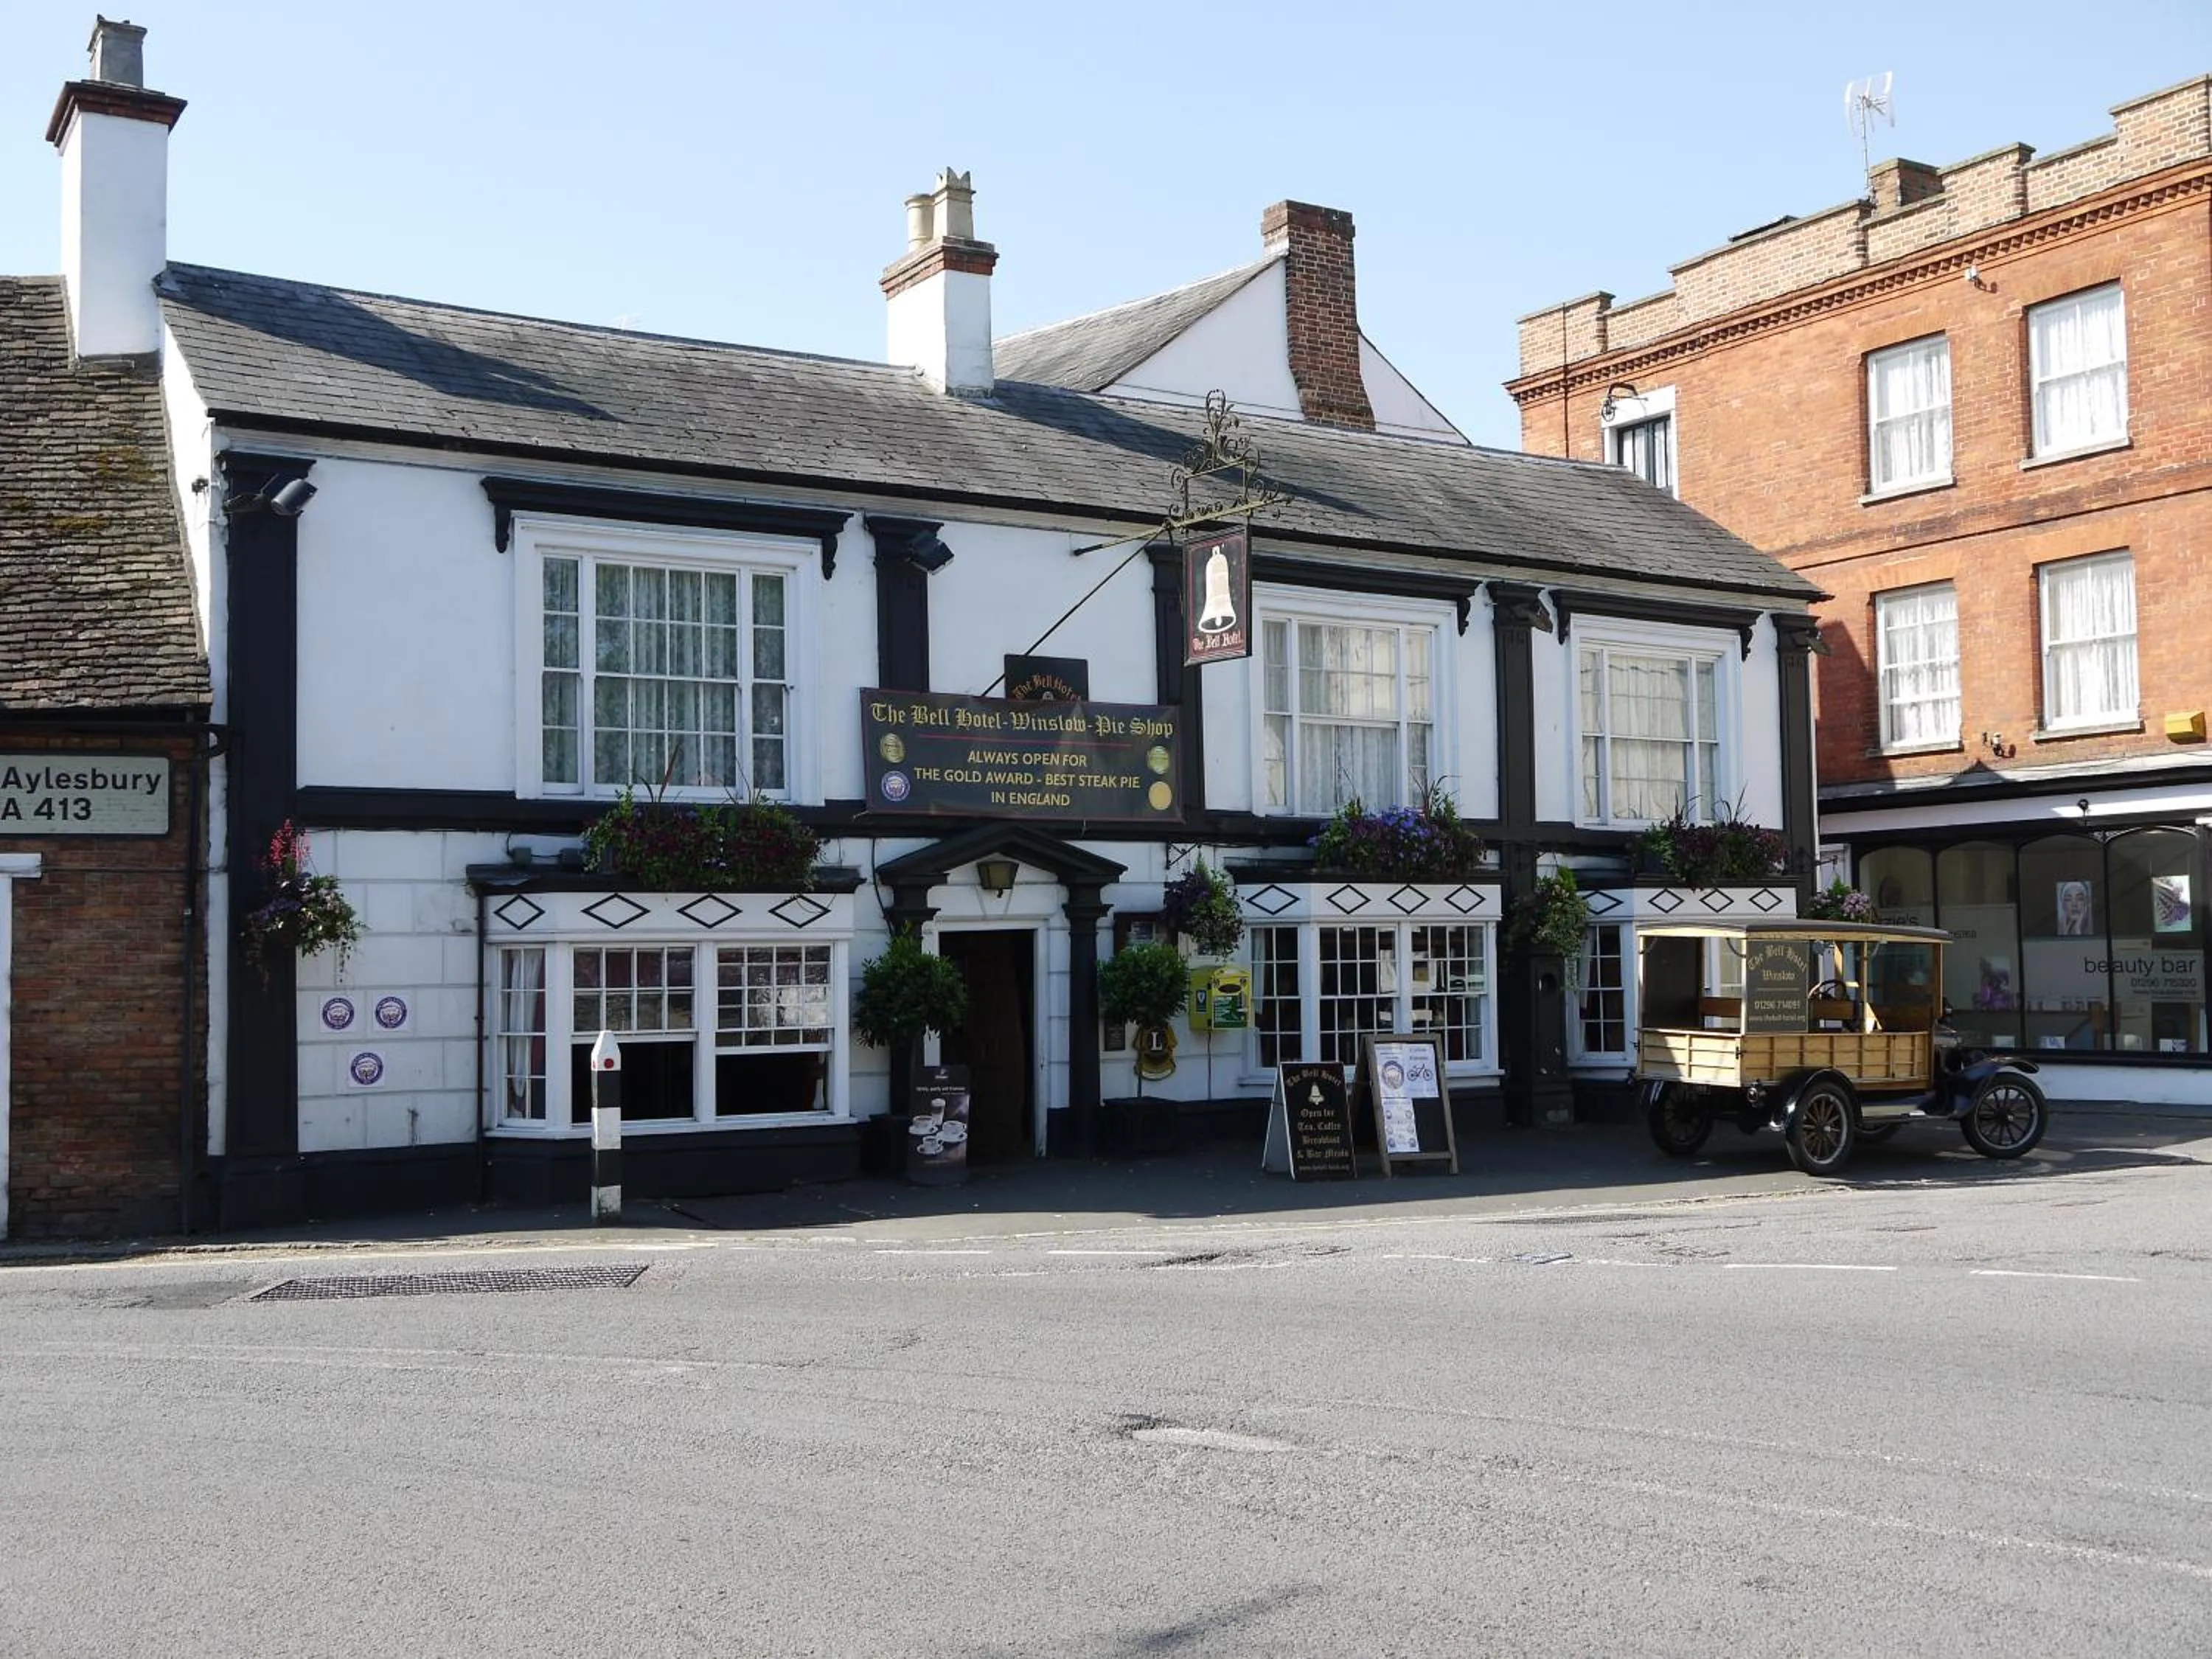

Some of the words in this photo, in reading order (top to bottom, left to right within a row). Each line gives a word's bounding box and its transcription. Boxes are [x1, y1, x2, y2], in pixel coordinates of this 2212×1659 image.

[1032, 674, 1053, 689] Bell
[870, 703, 906, 725] The
[911, 705, 950, 726] Bell
[1129, 717, 1174, 738] Shop
[967, 750, 1019, 765] ALWAYS
[1023, 753, 1060, 765] OPEN
[1062, 754, 1088, 767] FOR
[1, 767, 161, 795] Aylesbury
[914, 767, 941, 781] THE
[944, 769, 982, 782] GOLD
[985, 771, 1033, 785] AWARD
[1045, 774, 1076, 786] BEST
[1079, 775, 1118, 788] STEAK
[1120, 776, 1141, 788] PIE
[991, 791, 1005, 803] IN
[1009, 792, 1070, 805] ENGLAND
[1, 798, 22, 820] A
[33, 798, 91, 820] 413
[2084, 957, 2154, 977] beauty
[2161, 957, 2197, 973] bar
[1151, 1032, 1163, 1051] L
